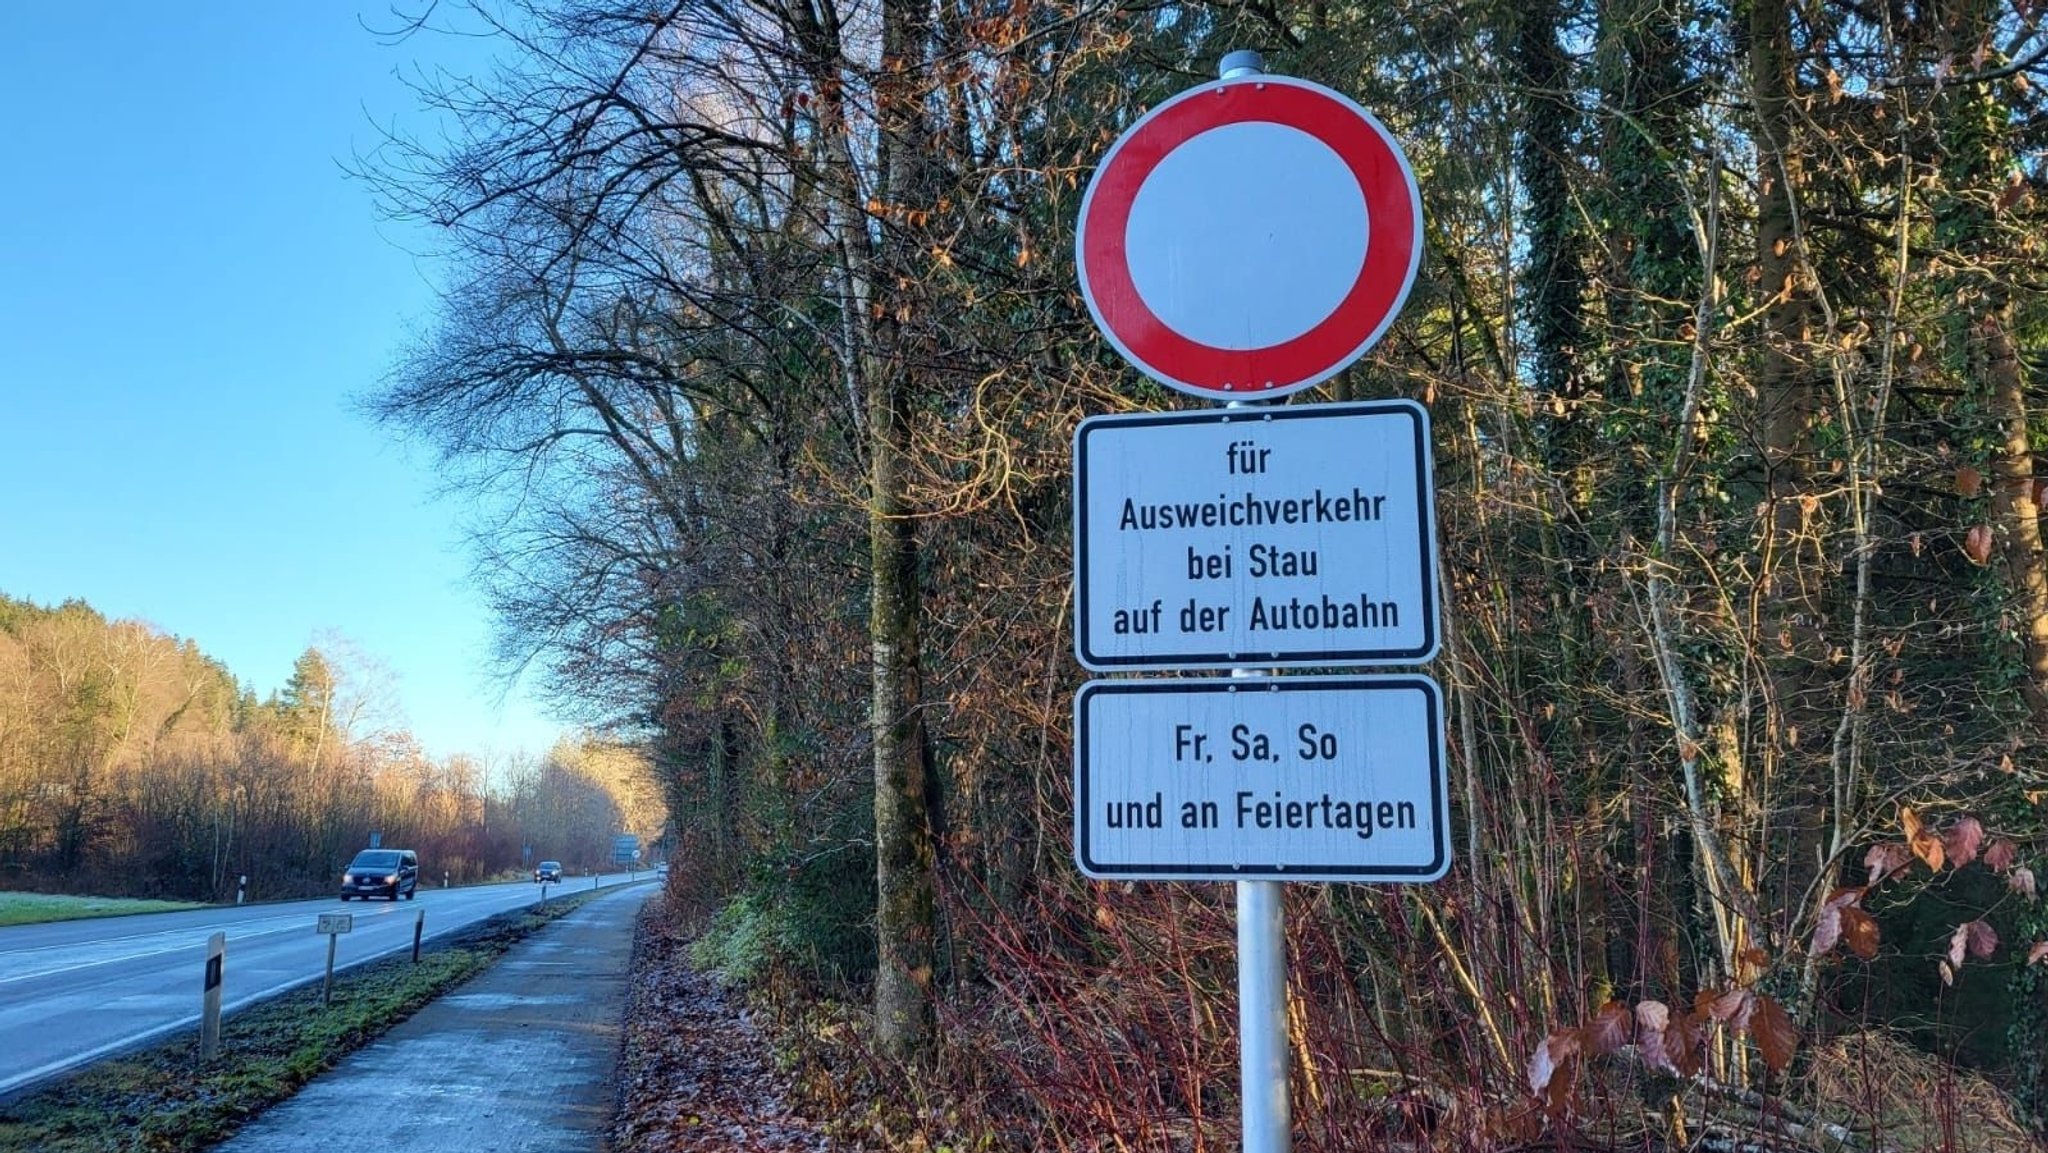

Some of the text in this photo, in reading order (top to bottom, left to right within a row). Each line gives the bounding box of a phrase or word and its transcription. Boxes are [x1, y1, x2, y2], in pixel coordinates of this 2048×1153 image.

[1227, 441, 1271, 474] für
[1120, 488, 1386, 530] Ausweichverkehr
[1188, 544, 1317, 579] bei Stau
[1114, 593, 1398, 634] auf der Autobahn
[1176, 723, 1337, 763] Fr, Sa, So
[1107, 791, 1415, 839] und an Feiertagen
